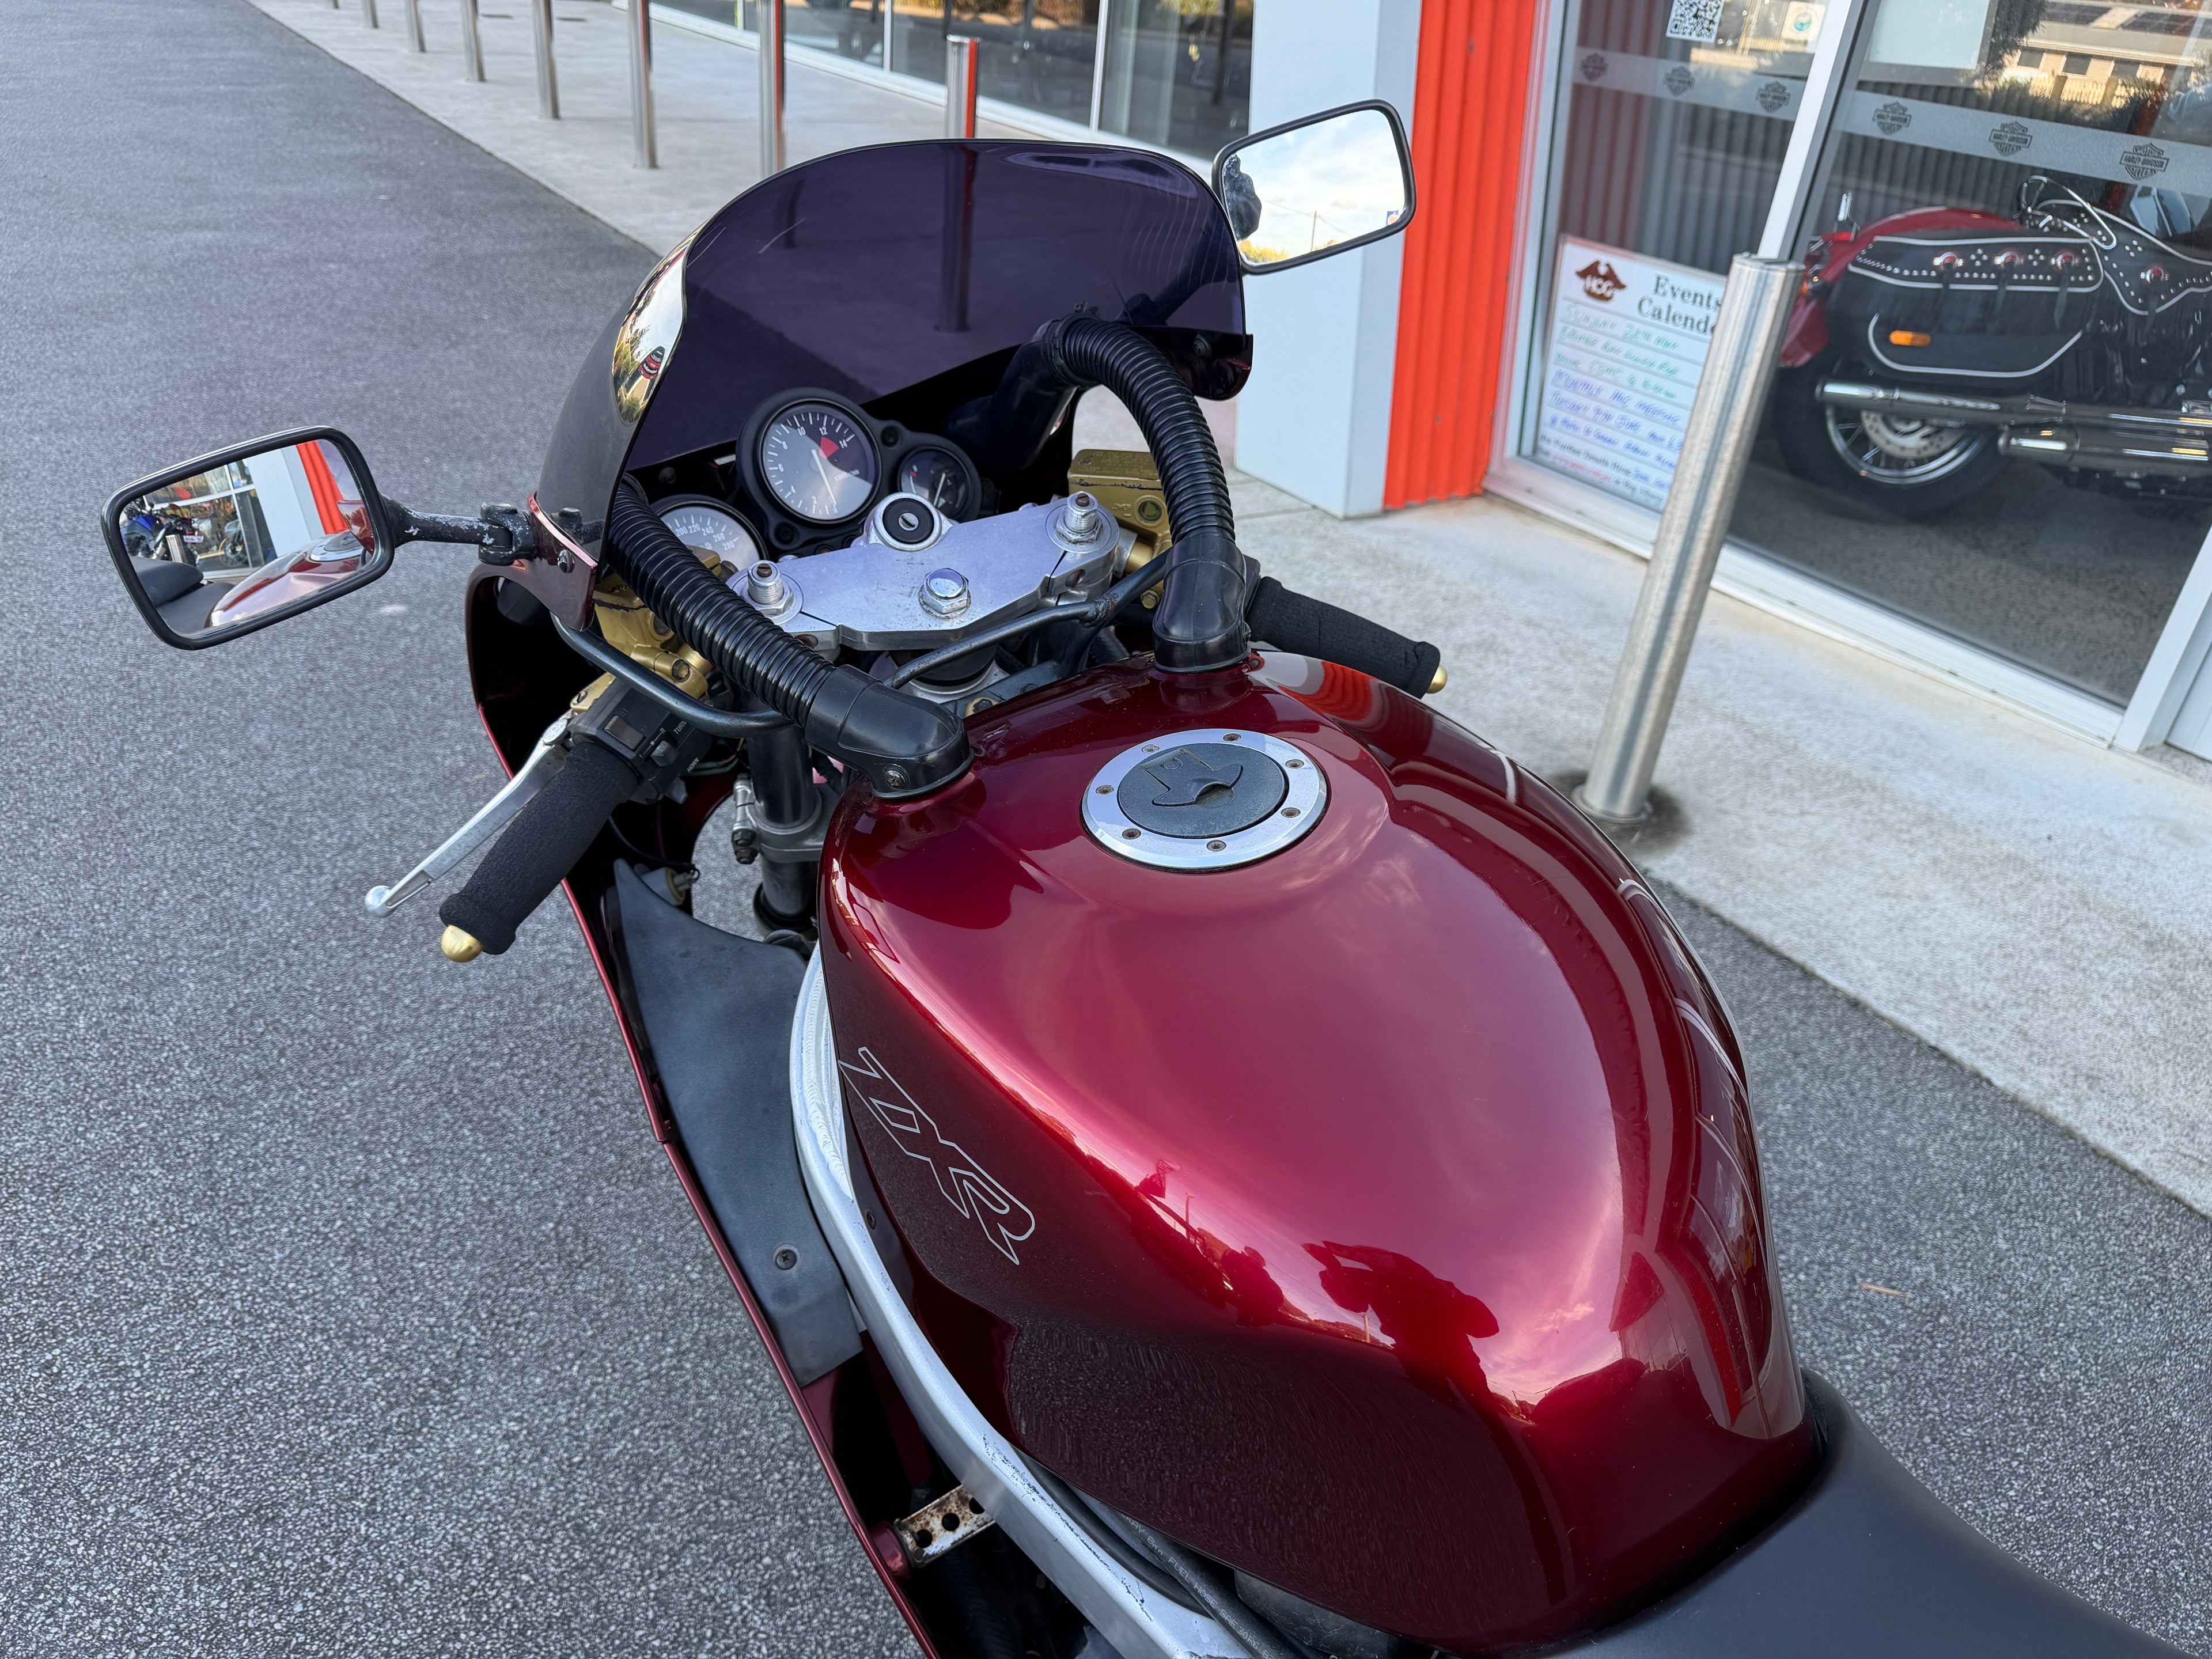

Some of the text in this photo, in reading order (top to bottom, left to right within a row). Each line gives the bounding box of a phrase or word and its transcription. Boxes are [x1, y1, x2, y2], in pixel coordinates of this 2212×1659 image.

[797, 427, 806, 436] 10
[819, 427, 828, 436] 12
[782, 441, 788, 450] 8
[839, 440, 847, 449] 14
[812, 495, 818, 505] 2
[675, 527, 688, 537] 200
[688, 523, 700, 534] 220
[702, 526, 714, 536] 240
[713, 532, 726, 543] 260
[722, 540, 735, 551] 280
[673, 719, 687, 734] TURN
[687, 757, 699, 773] HORN
[839, 1047, 1035, 1266] ZXR
